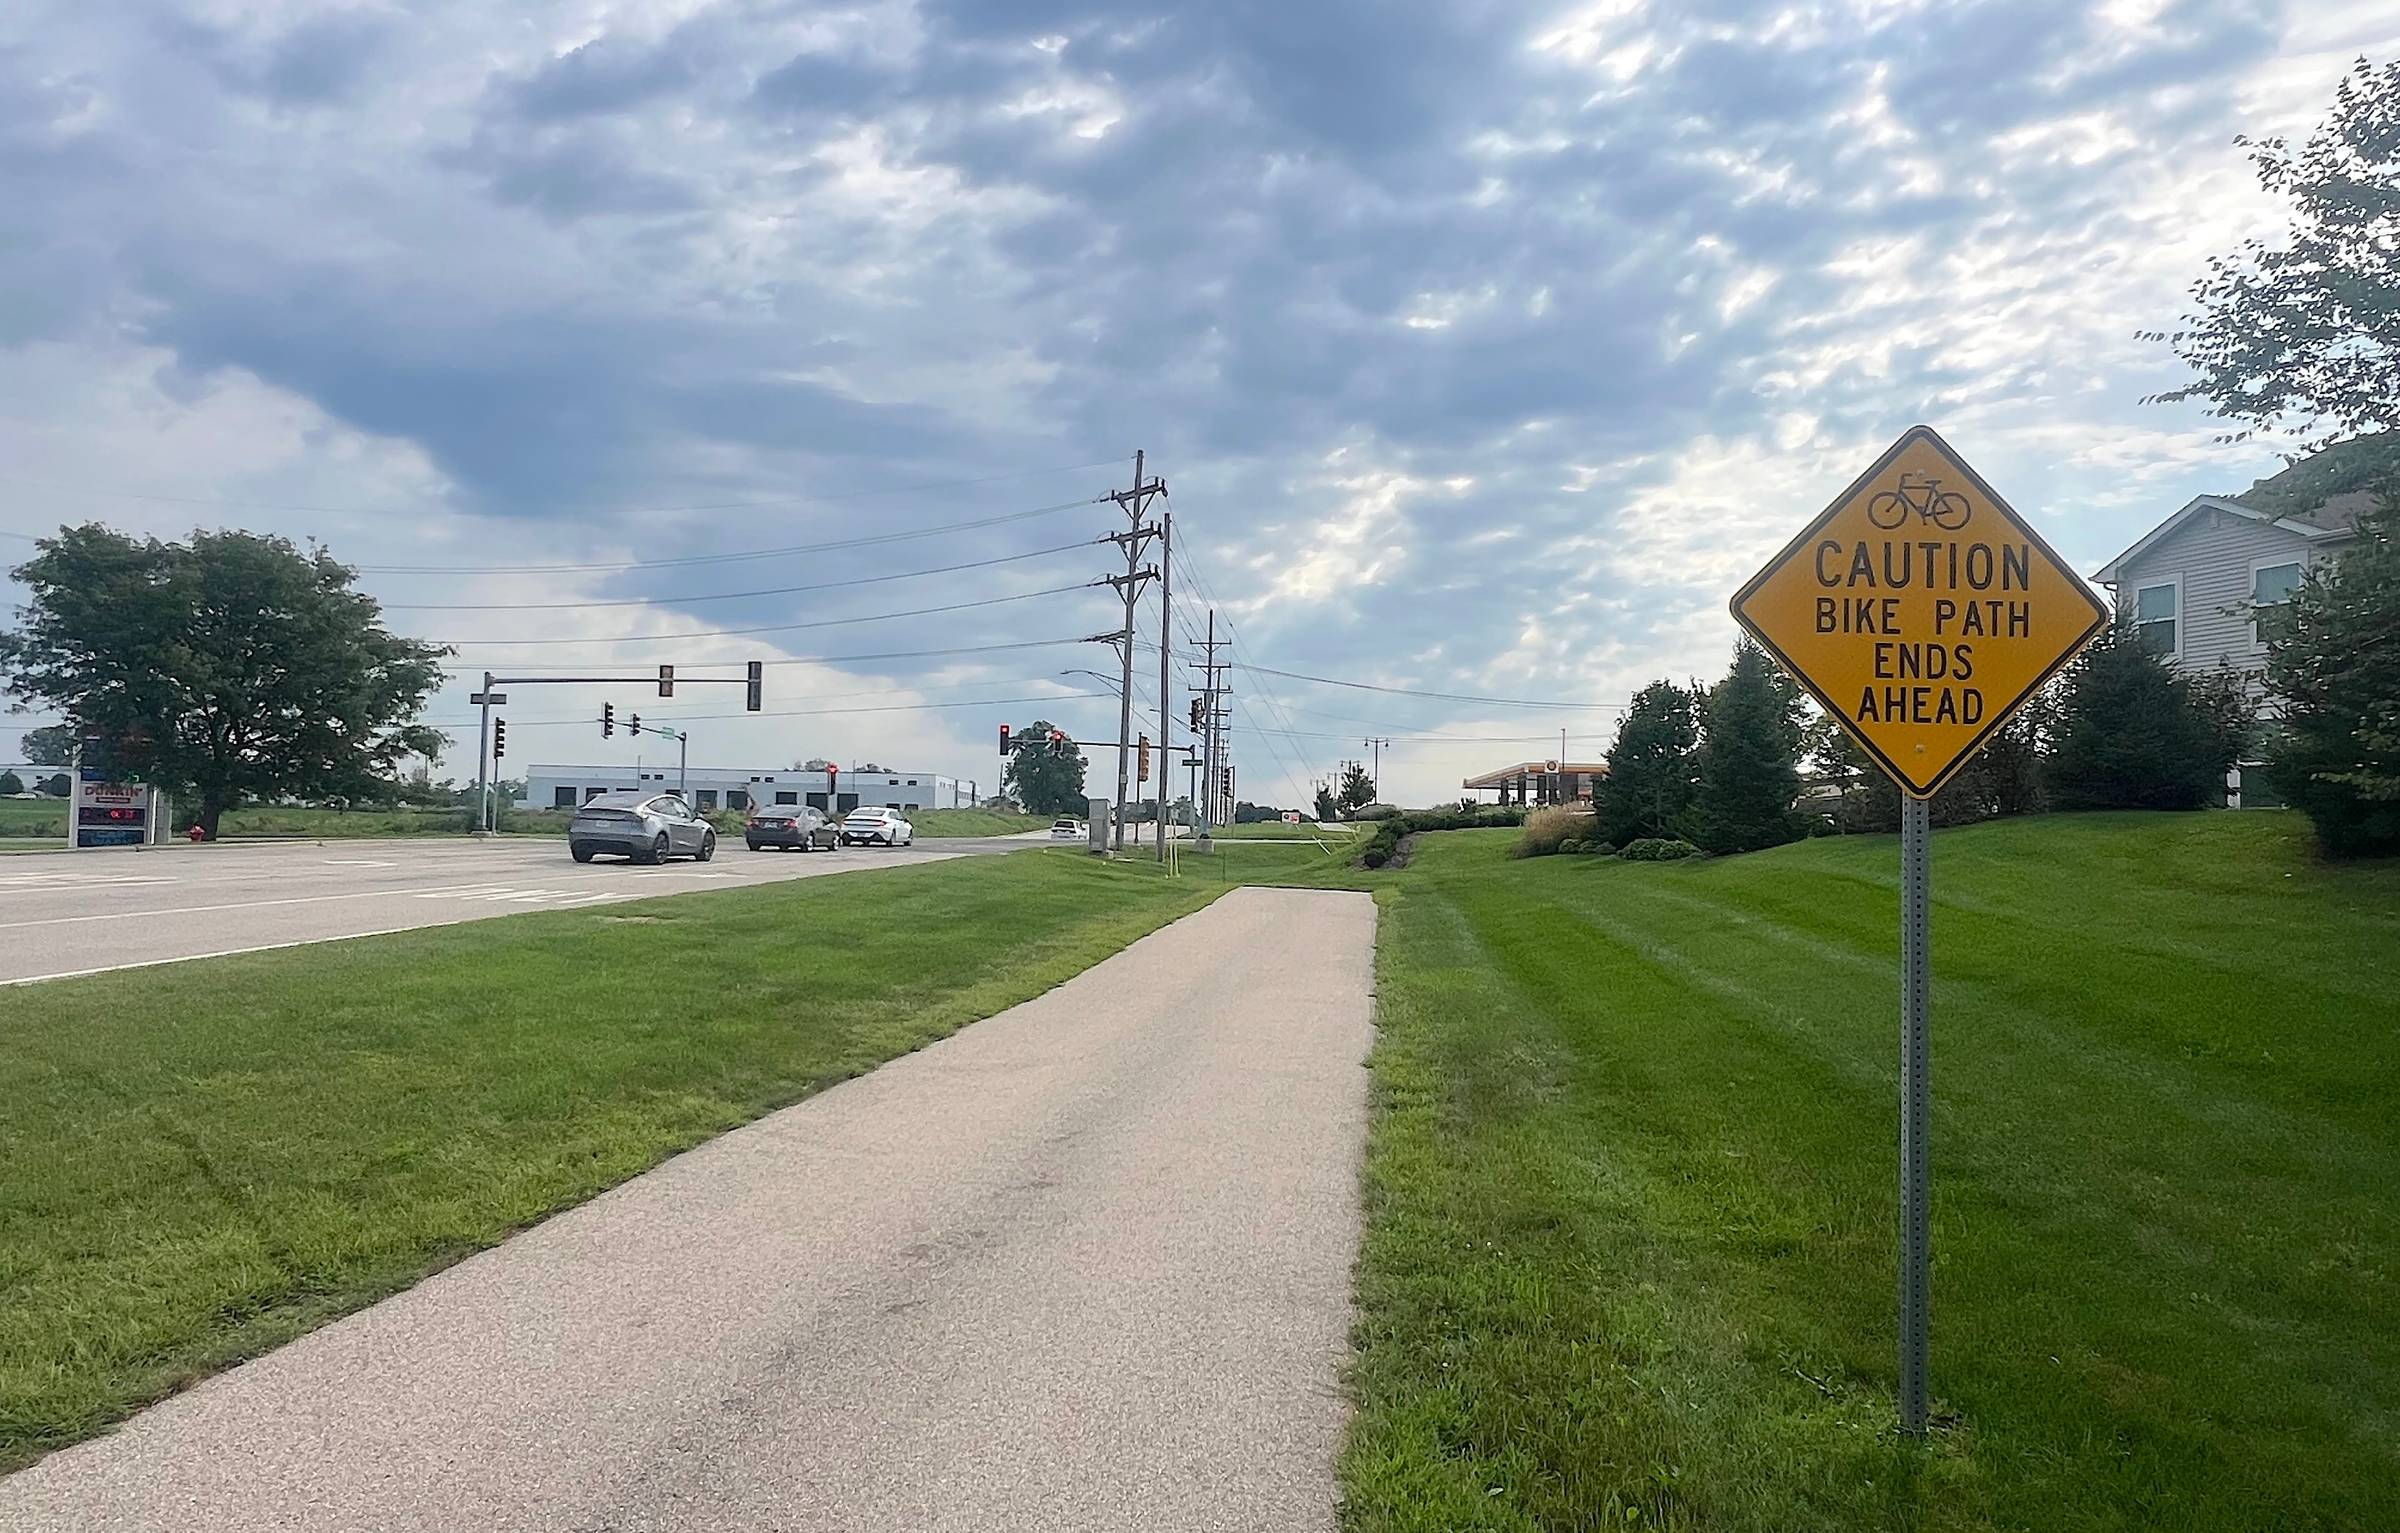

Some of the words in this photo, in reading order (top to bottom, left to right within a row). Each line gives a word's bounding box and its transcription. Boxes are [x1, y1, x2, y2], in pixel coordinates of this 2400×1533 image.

[1816, 541, 2029, 590] CAUTION
[1816, 598, 1901, 634] BIKE
[1936, 600, 2029, 637] PATH
[1875, 643, 1972, 680] ENDS
[1857, 687, 1983, 725] AHEAD
